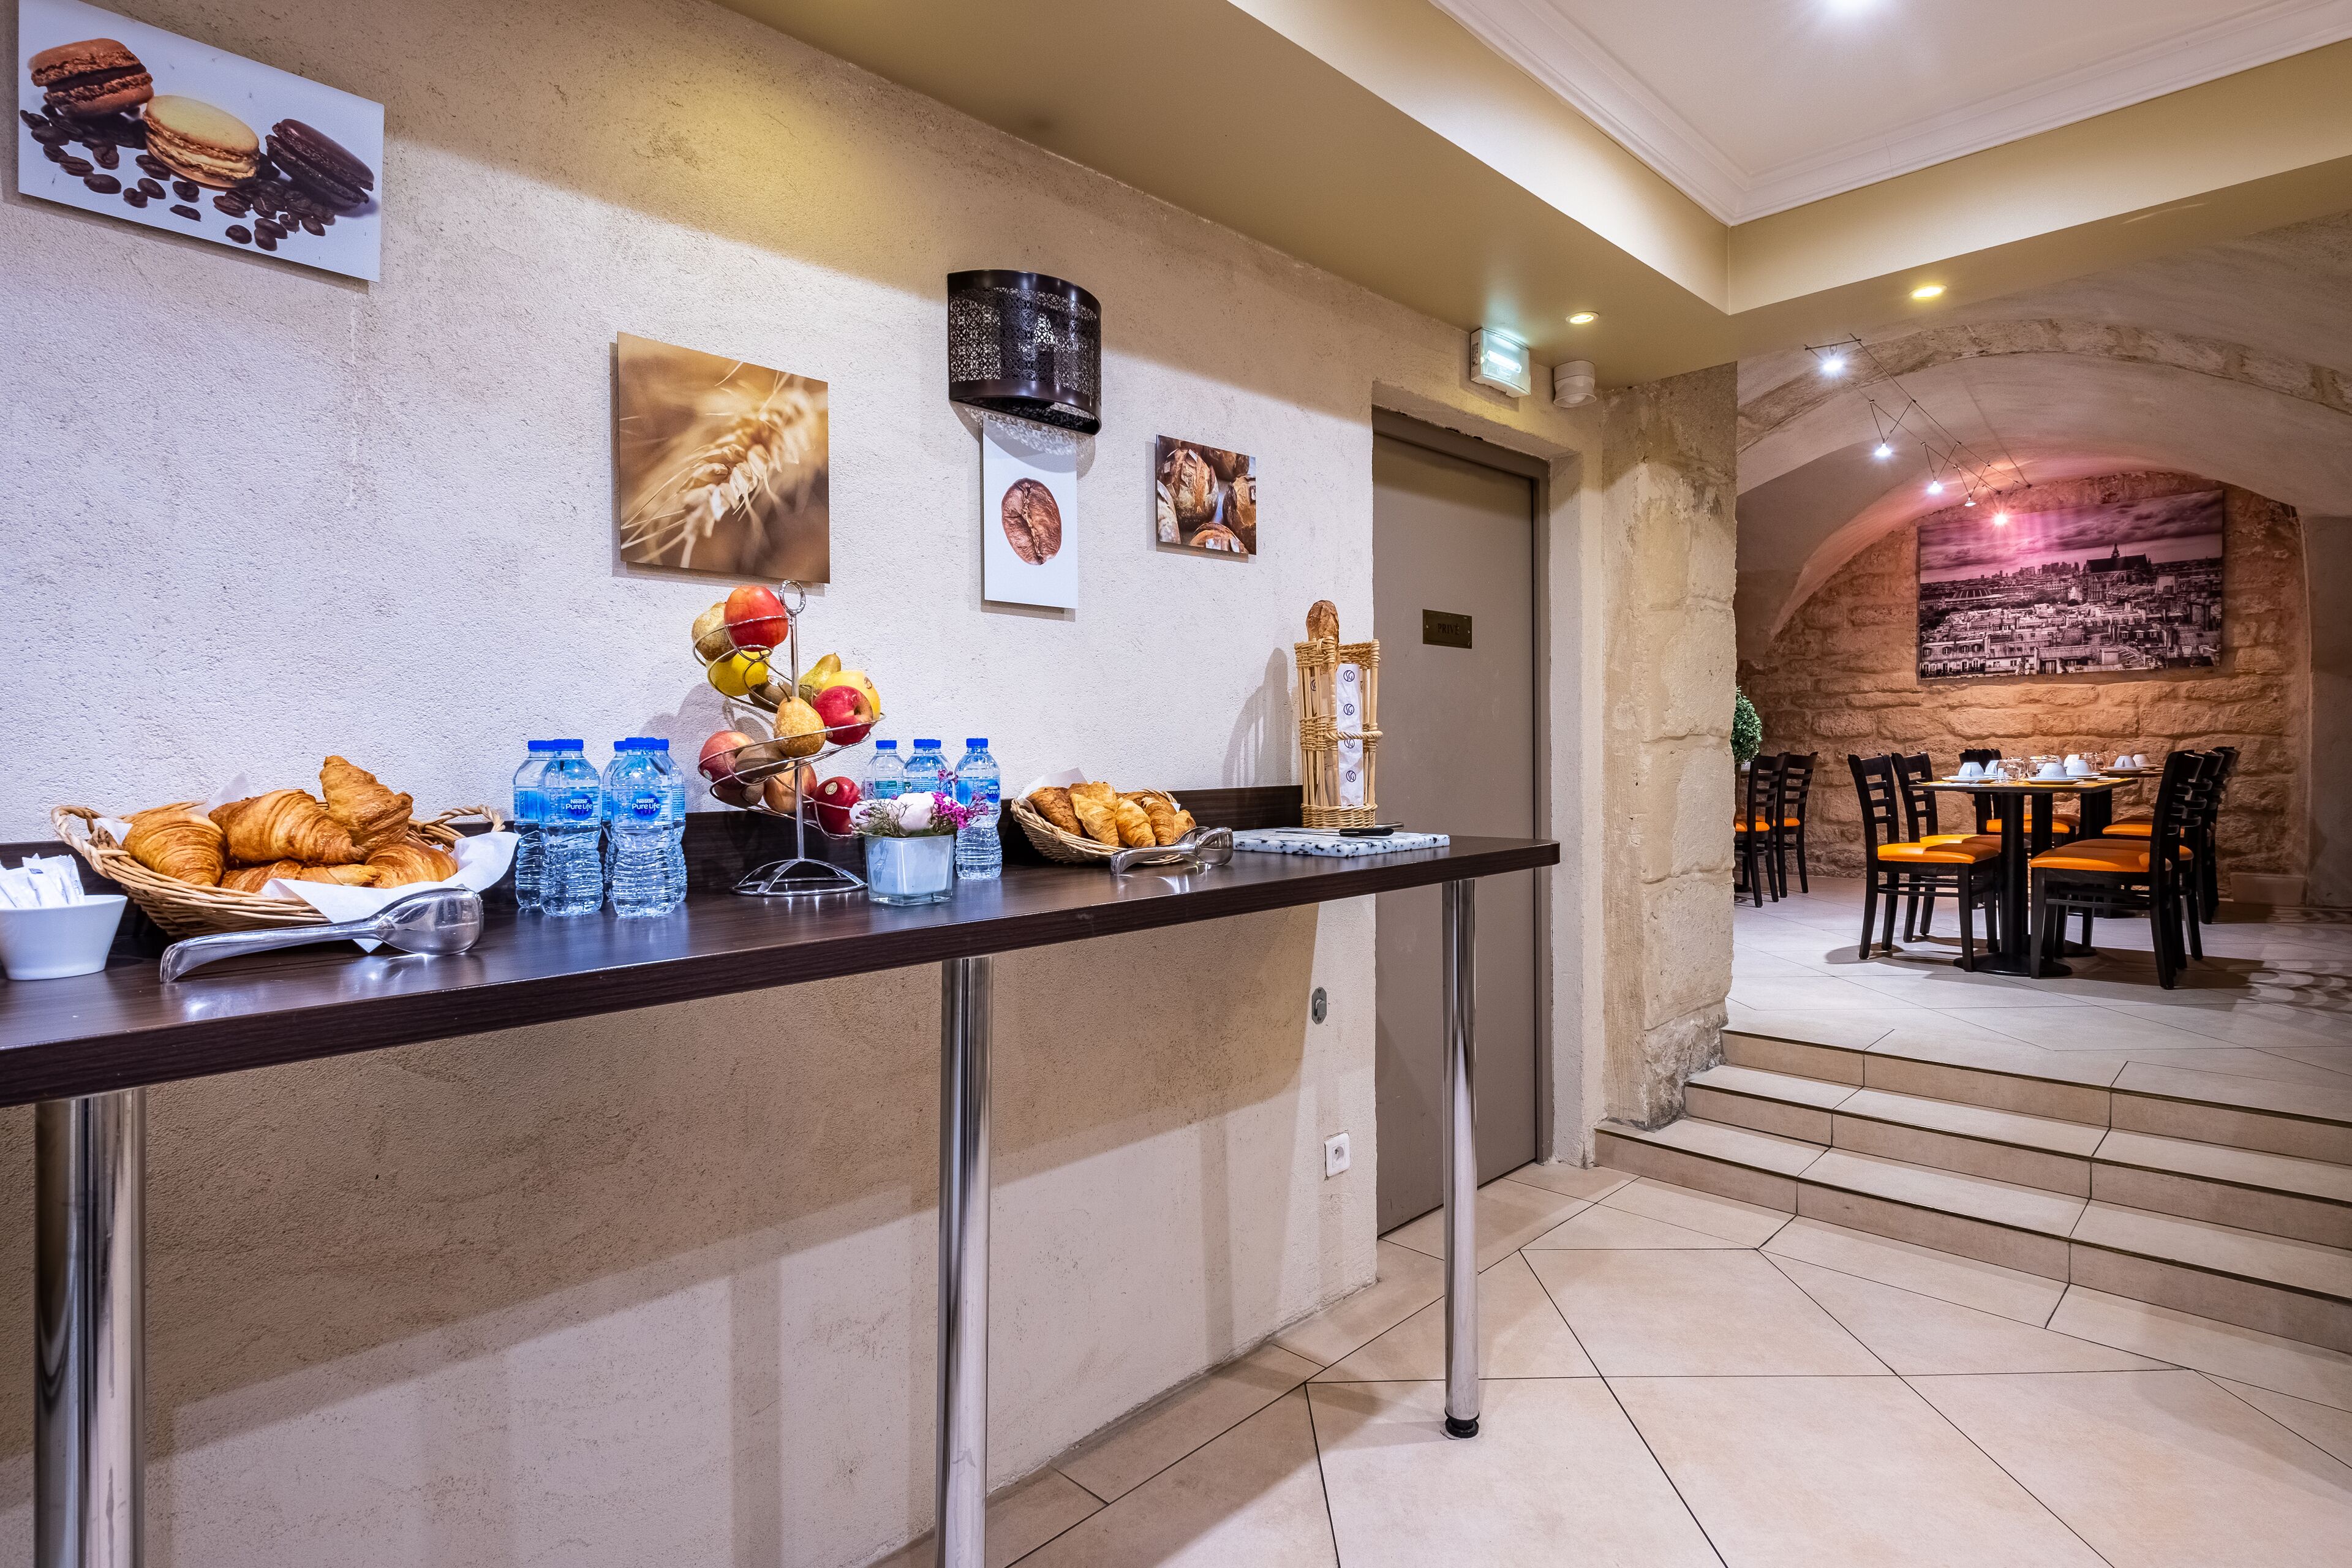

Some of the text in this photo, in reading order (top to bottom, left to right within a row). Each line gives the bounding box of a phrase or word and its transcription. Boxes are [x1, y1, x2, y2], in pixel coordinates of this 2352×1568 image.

[1437, 623, 1460, 635] PRIVÉ
[582, 803, 593, 812] Life
[649, 802, 660, 812] Life
